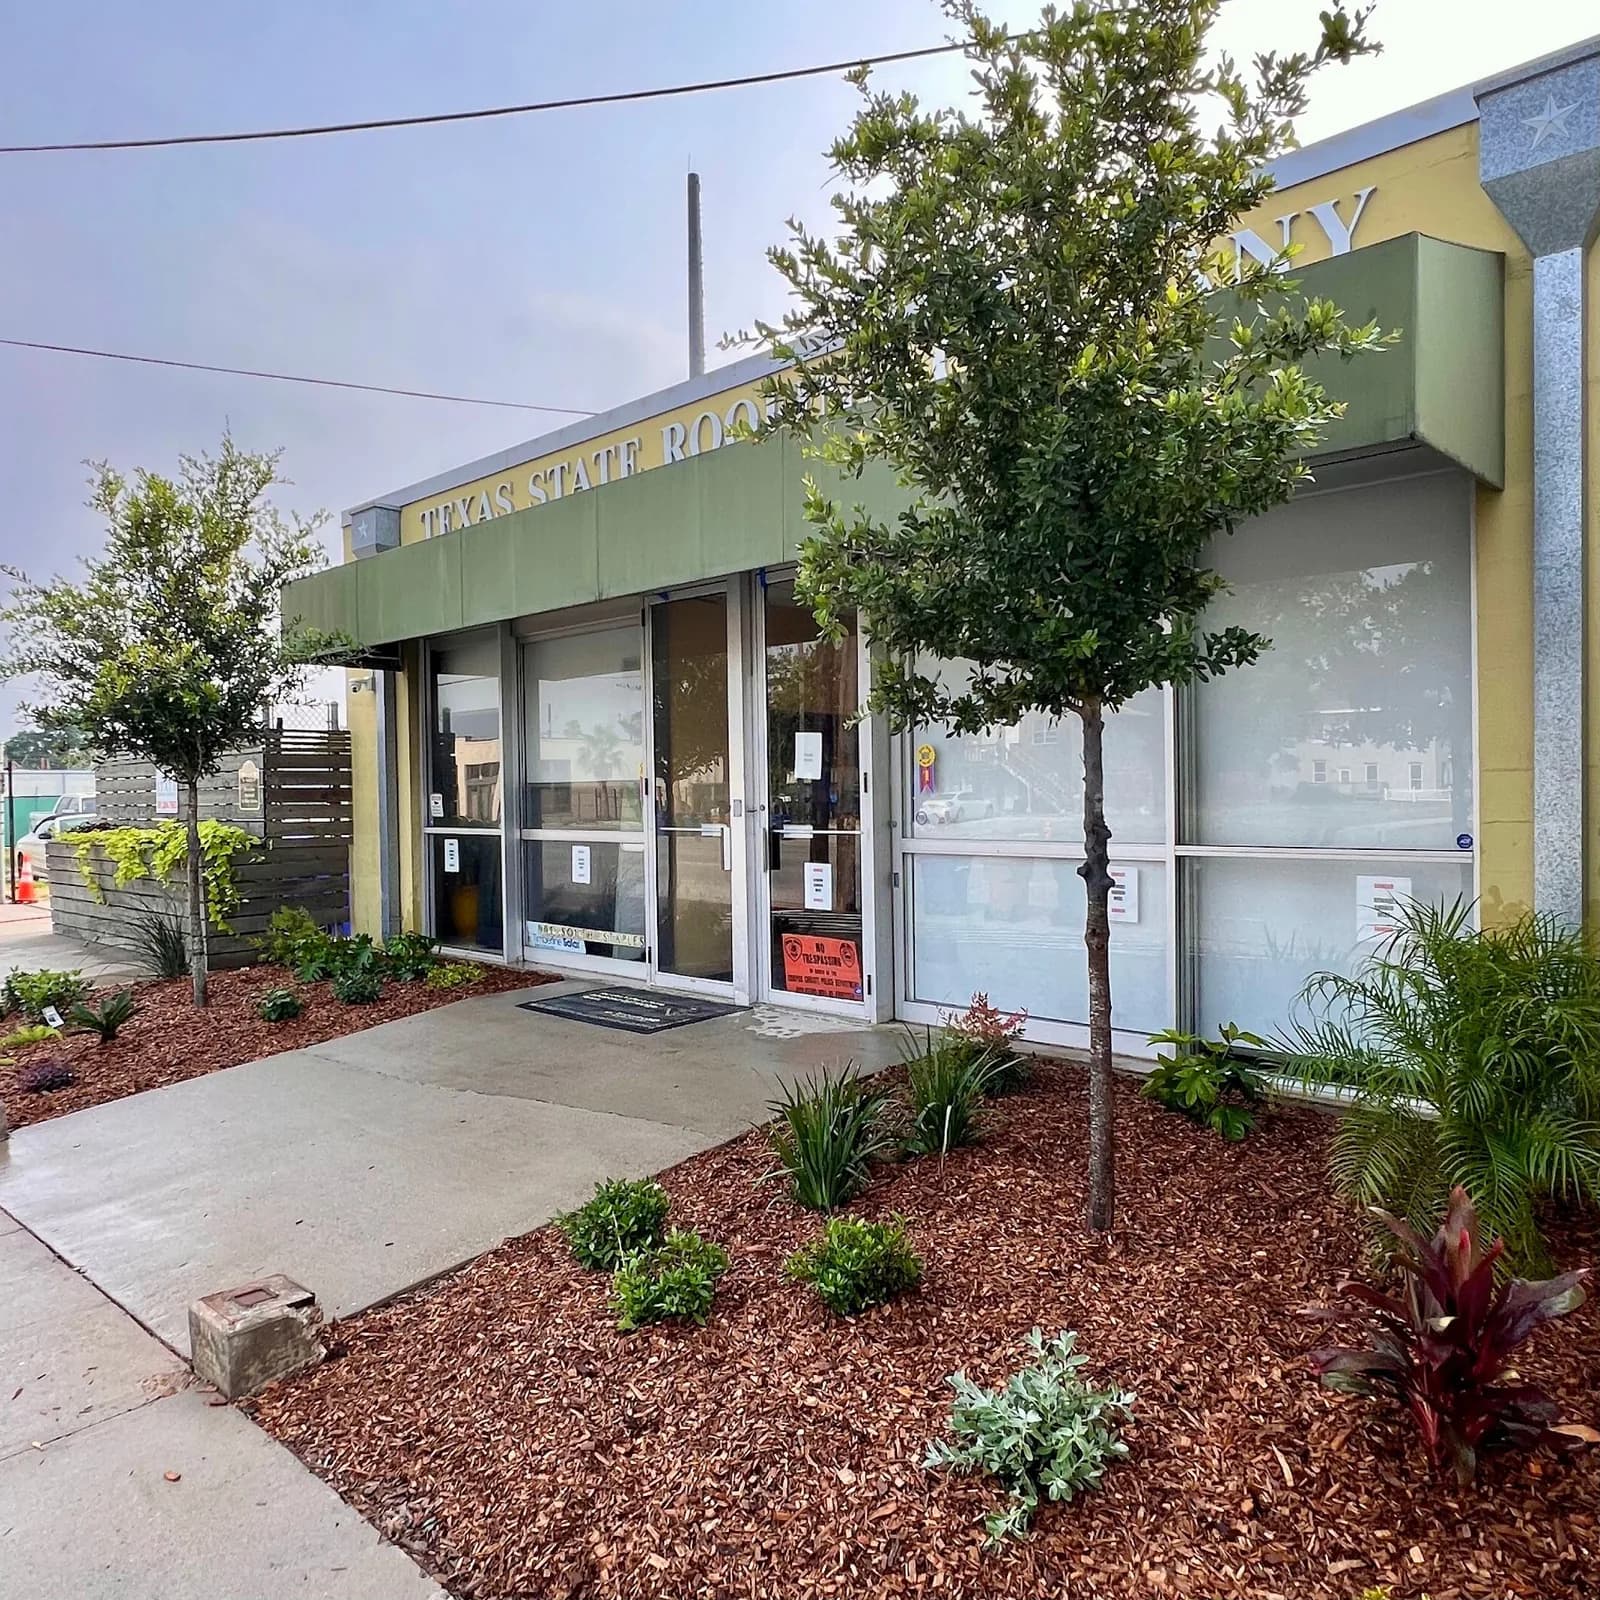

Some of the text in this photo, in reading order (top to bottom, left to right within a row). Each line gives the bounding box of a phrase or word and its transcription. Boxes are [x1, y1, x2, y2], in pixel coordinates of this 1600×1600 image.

[420, 482, 515, 539] TEXAS
[527, 436, 643, 504] STATE
[815, 942, 825, 954] NO
[802, 953, 842, 967] TRESPASSING
